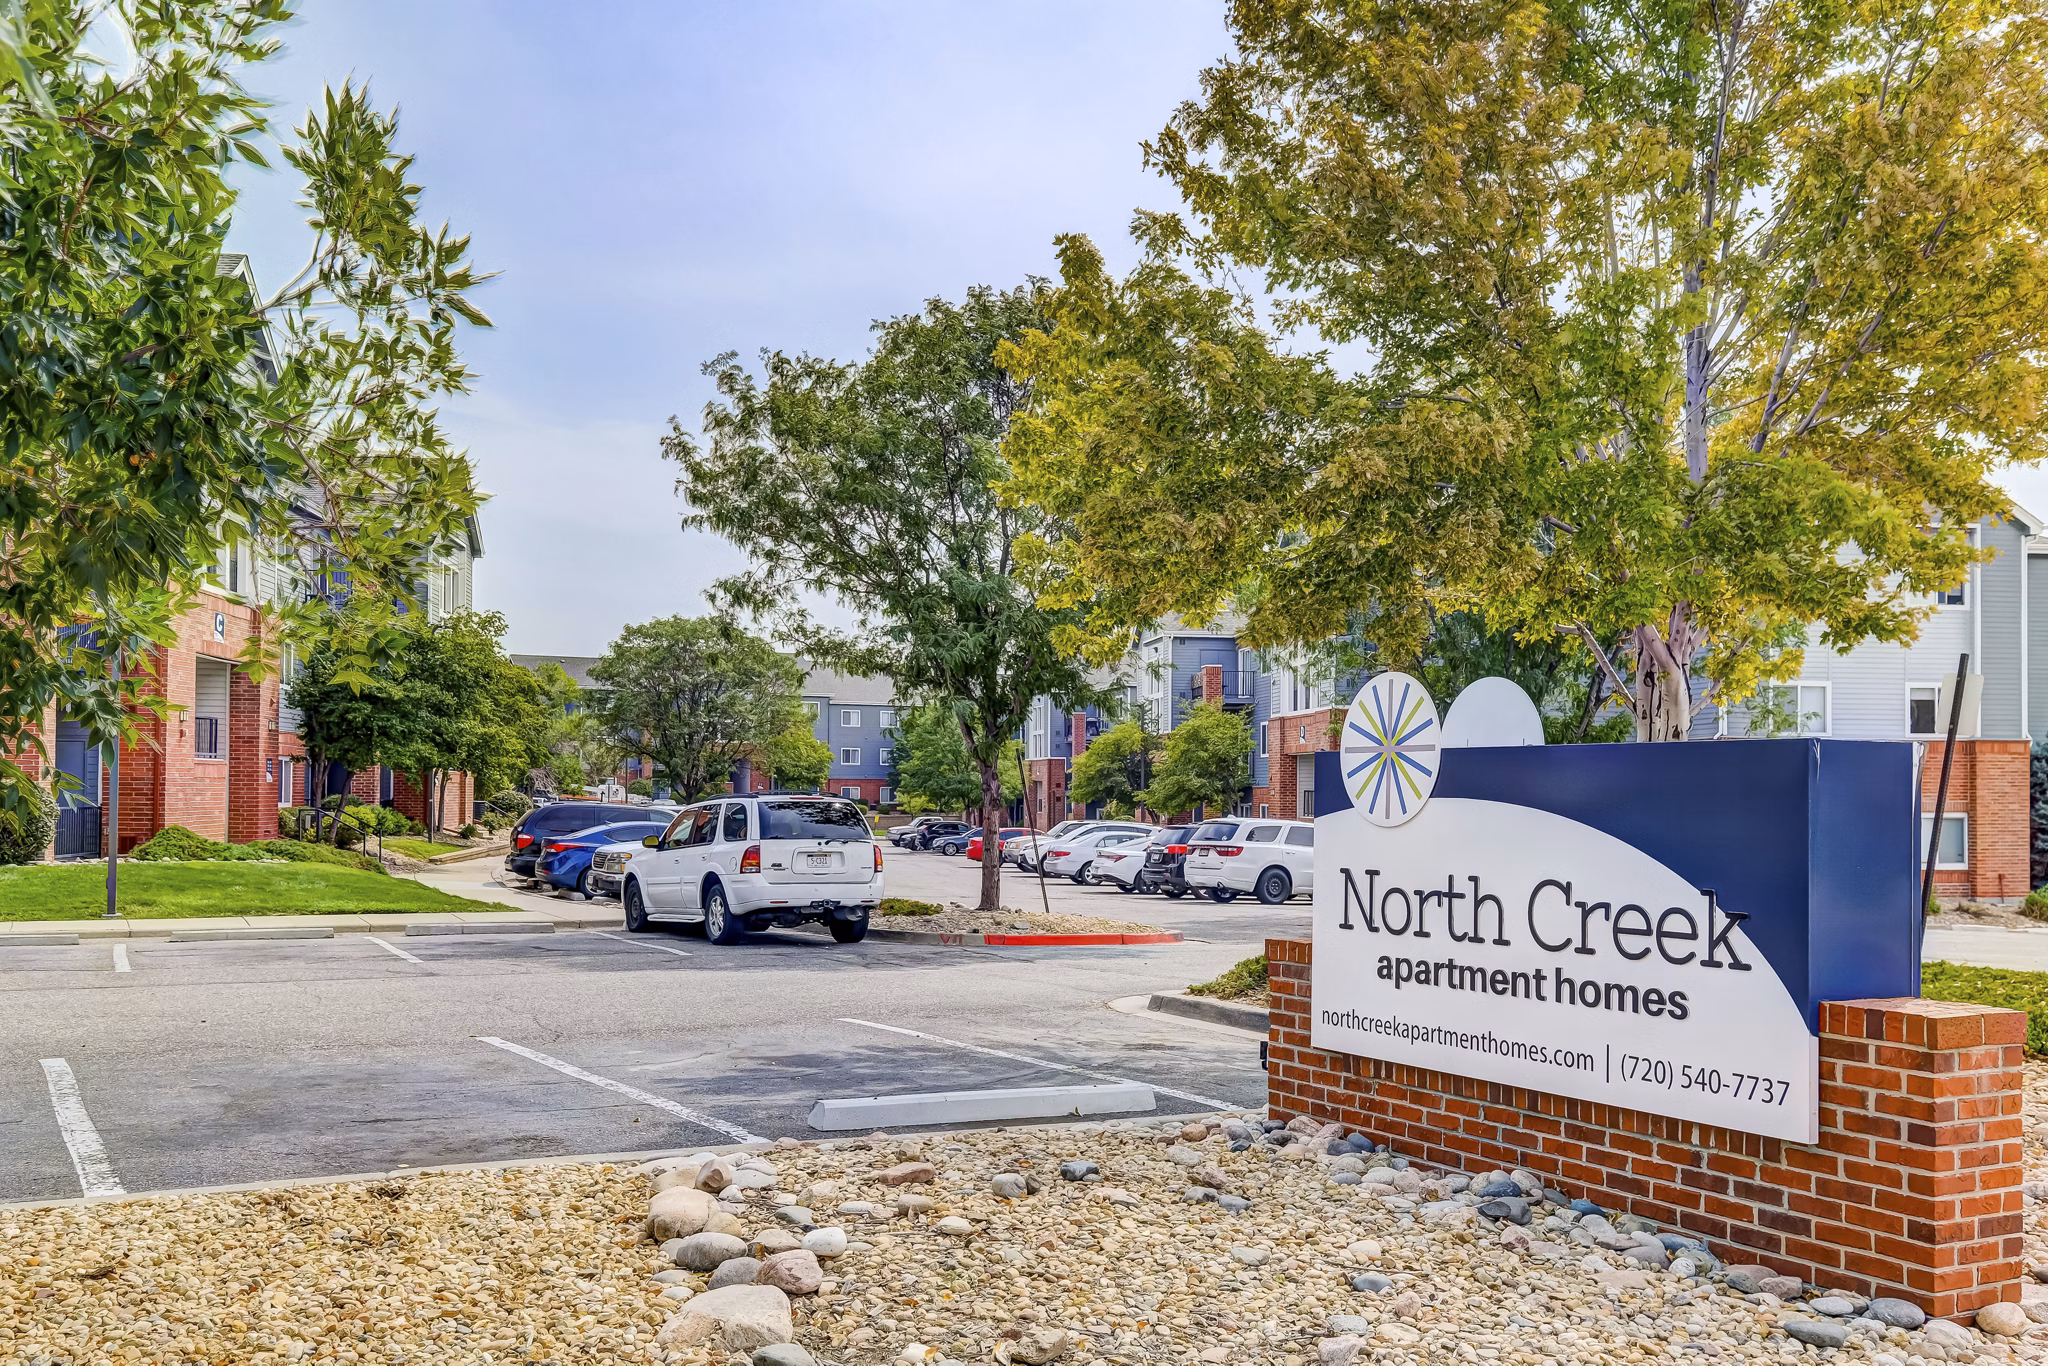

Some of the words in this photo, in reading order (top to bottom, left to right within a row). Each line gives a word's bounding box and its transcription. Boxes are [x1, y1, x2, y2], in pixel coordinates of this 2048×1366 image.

[216, 614, 223, 632] C
[1338, 868, 1511, 947] North
[1528, 879, 1752, 971] Creek
[1376, 955, 1548, 1002] apartment
[1555, 967, 1690, 1020] homes
[1321, 1007, 1595, 1073] northcreekapartmenthomes.com
[1620, 1053, 1675, 1091] (720)
[1680, 1064, 1791, 1107] 540-7737
